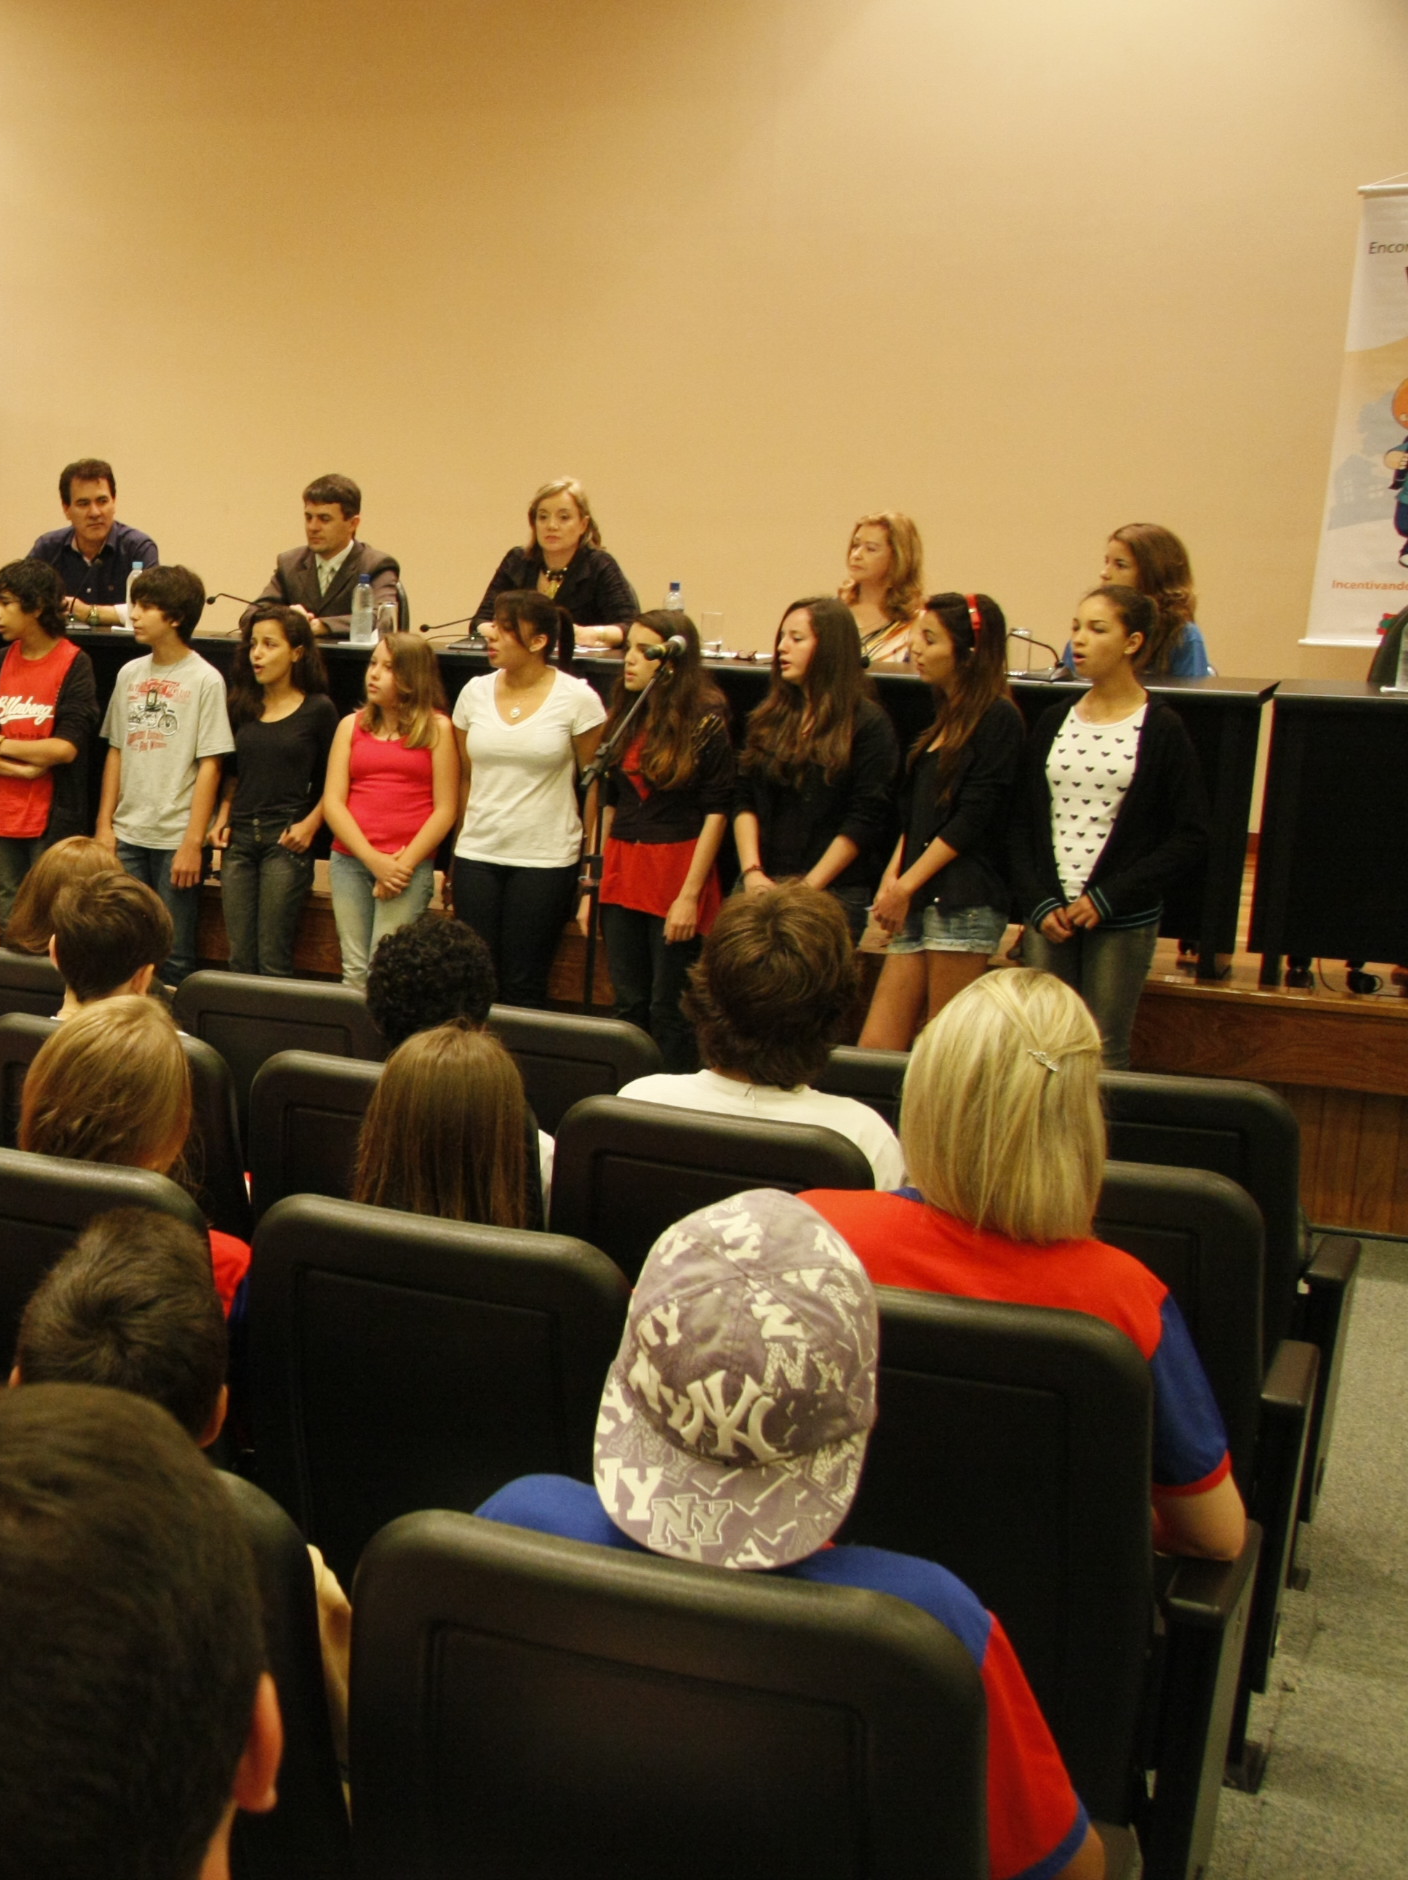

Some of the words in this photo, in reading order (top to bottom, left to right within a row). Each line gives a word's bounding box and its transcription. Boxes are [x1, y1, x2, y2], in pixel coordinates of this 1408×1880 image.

[1368, 241, 1408, 255] Enco
[680, 1369, 798, 1463] NY
[647, 1493, 733, 1546] NY
